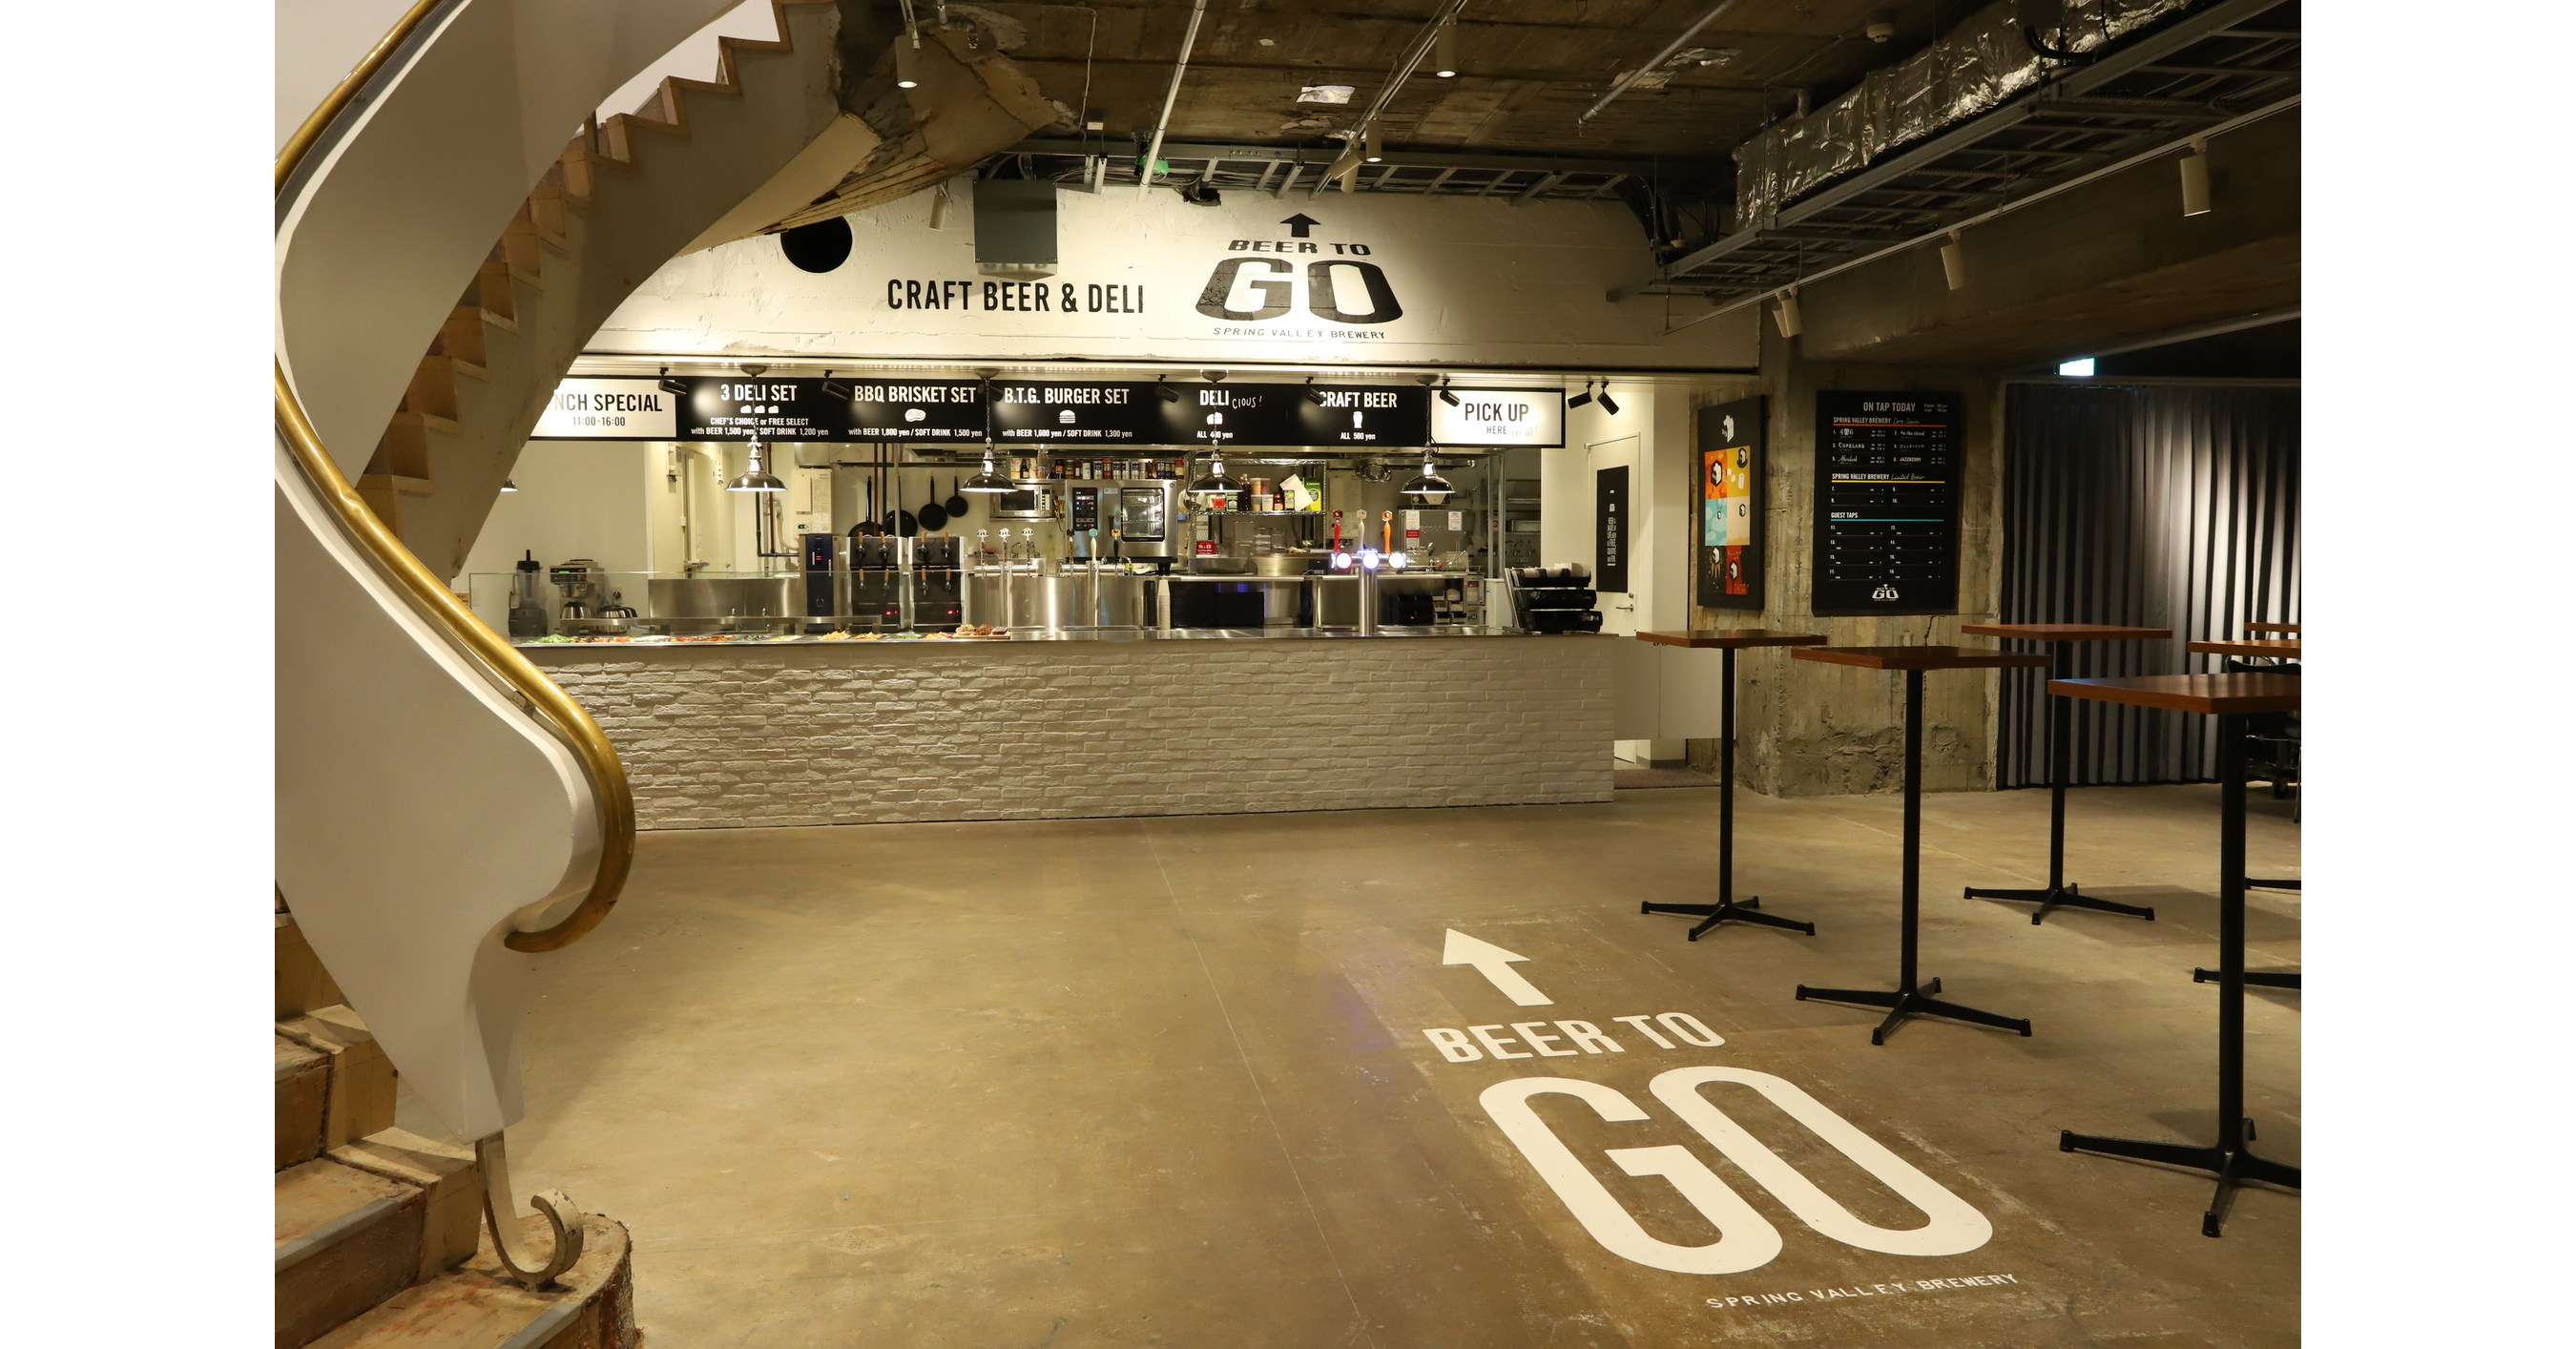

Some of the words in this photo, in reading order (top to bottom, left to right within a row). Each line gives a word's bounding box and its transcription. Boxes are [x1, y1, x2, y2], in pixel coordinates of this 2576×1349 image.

[1229, 239, 1319, 255] BEER
[1329, 242, 1371, 256] TO
[887, 278, 973, 311] CRAFT
[984, 281, 1050, 312] BEER
[1061, 283, 1079, 313] &
[1088, 283, 1144, 314] DELI
[1195, 257, 1403, 324] GO
[1213, 326, 1266, 338] SPRING
[1271, 328, 1325, 339] VALLEY
[1330, 330, 1386, 340] BREWERY
[720, 384, 730, 402] 3
[734, 384, 766, 402] DELI
[771, 384, 798, 402] SET
[854, 385, 885, 403] BBQ
[888, 385, 947, 403] BRISKET
[950, 386, 976, 403] SET
[1004, 387, 1041, 405] B.T.G.
[1045, 387, 1101, 405] BURGER
[1104, 388, 1130, 405] SET
[1199, 389, 1230, 405] DELI
[1319, 391, 1361, 408] CRAFT
[1363, 391, 1398, 408] BEER
[545, 393, 588, 411] NCH
[593, 393, 663, 412] SPECIAL
[1863, 402, 1874, 411] ON
[1876, 402, 1890, 412] TAP
[1891, 402, 1916, 412] TODAY
[572, 416, 626, 426] 11:00-16:00
[710, 417, 734, 425] CHEF'S
[735, 417, 759, 425] CHOICE
[1465, 403, 1503, 421] PICK
[1507, 404, 1529, 422] UP
[724, 427, 741, 436] 1,500
[800, 428, 816, 437] 1,200
[848, 427, 862, 436] with
[915, 428, 930, 437] SOFT
[1196, 430, 1208, 439] ALL
[1340, 431, 1351, 440] ALL
[1486, 425, 1507, 435] HERE
[1872, 590, 1899, 599] GO
[1423, 1020, 1626, 1064] BEER
[1612, 1012, 1726, 1049] TO
[1479, 1066, 1993, 1276] GO
[1705, 1290, 1805, 1310] SPRING
[1808, 1281, 1907, 1301] VALLEY
[1915, 1272, 2020, 1293] BREWERY
